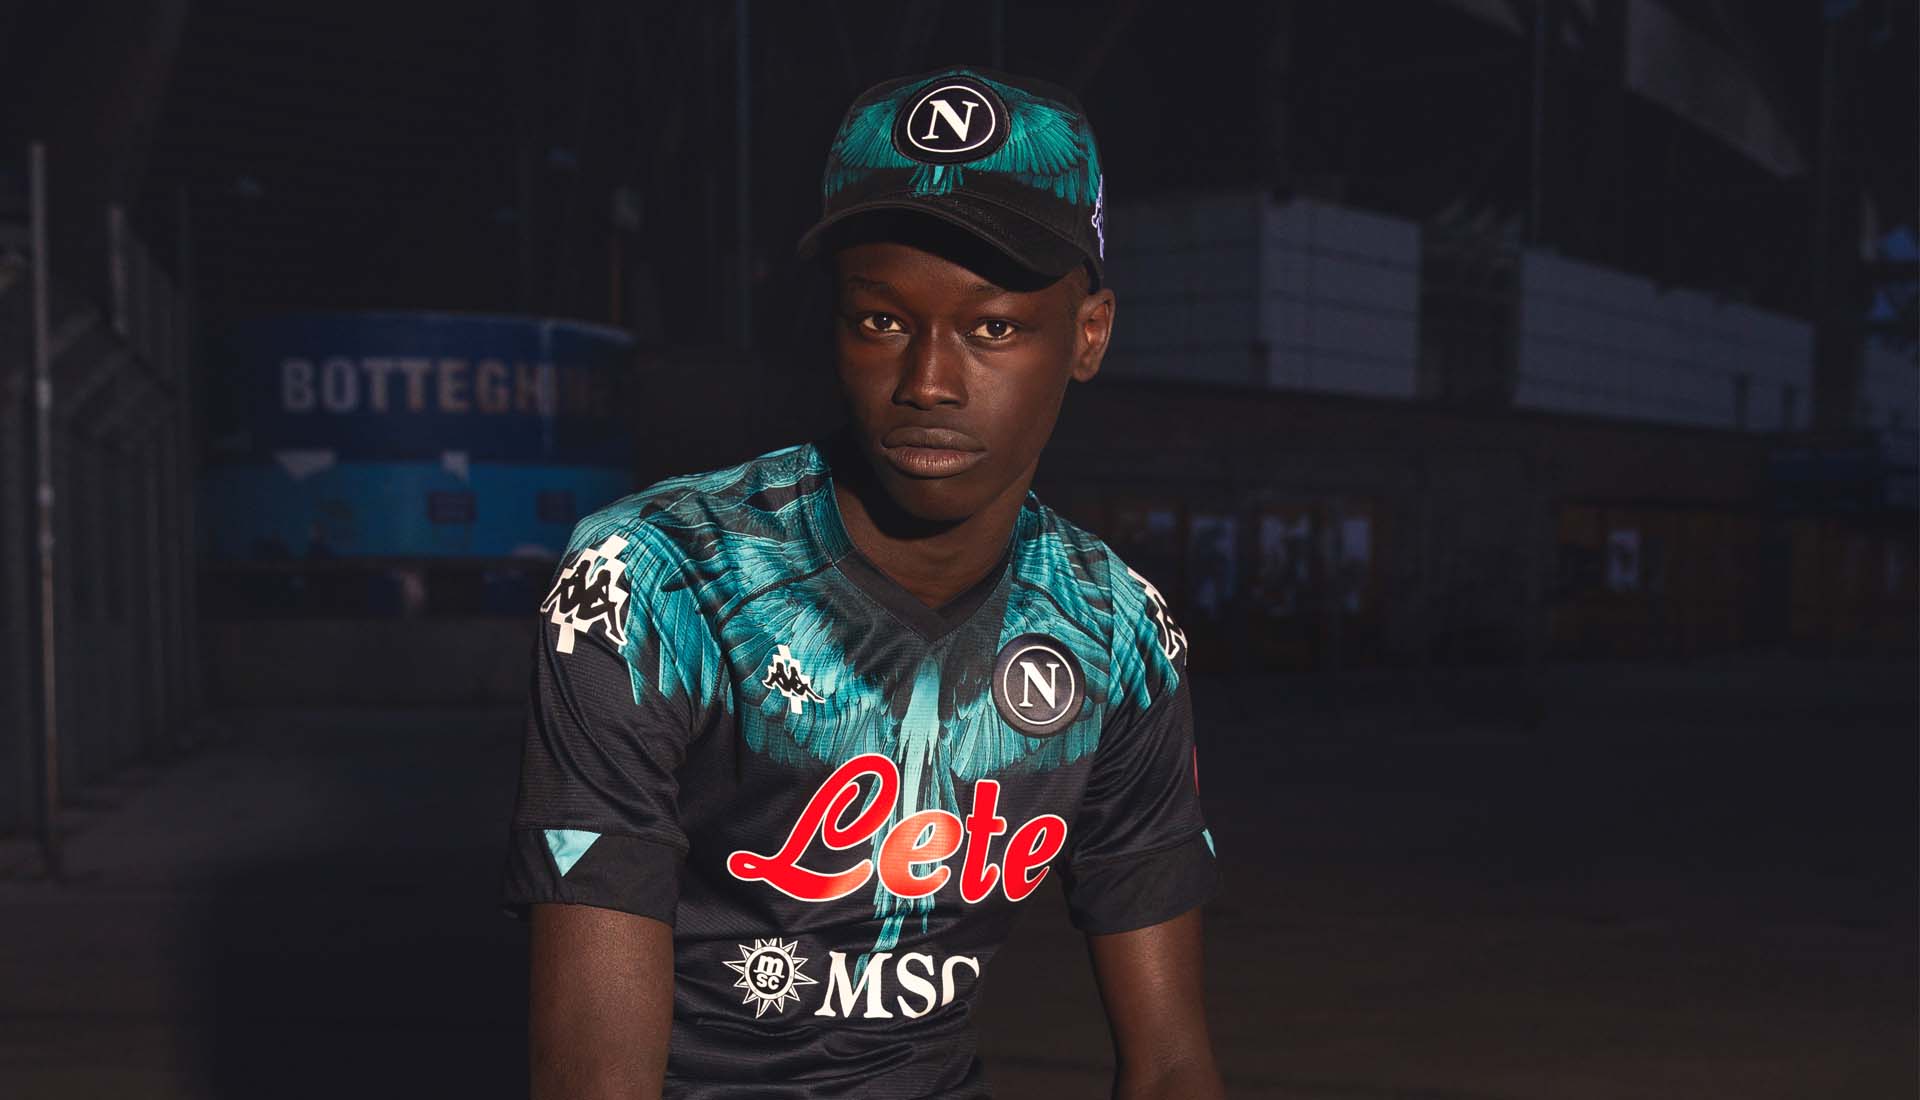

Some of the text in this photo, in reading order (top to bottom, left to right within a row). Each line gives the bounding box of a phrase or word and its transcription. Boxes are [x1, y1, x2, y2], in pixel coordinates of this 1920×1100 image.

[921, 99, 979, 143] N
[1018, 661, 1060, 709] N
[726, 752, 1068, 904] Lete
[814, 950, 980, 1019] MSC
